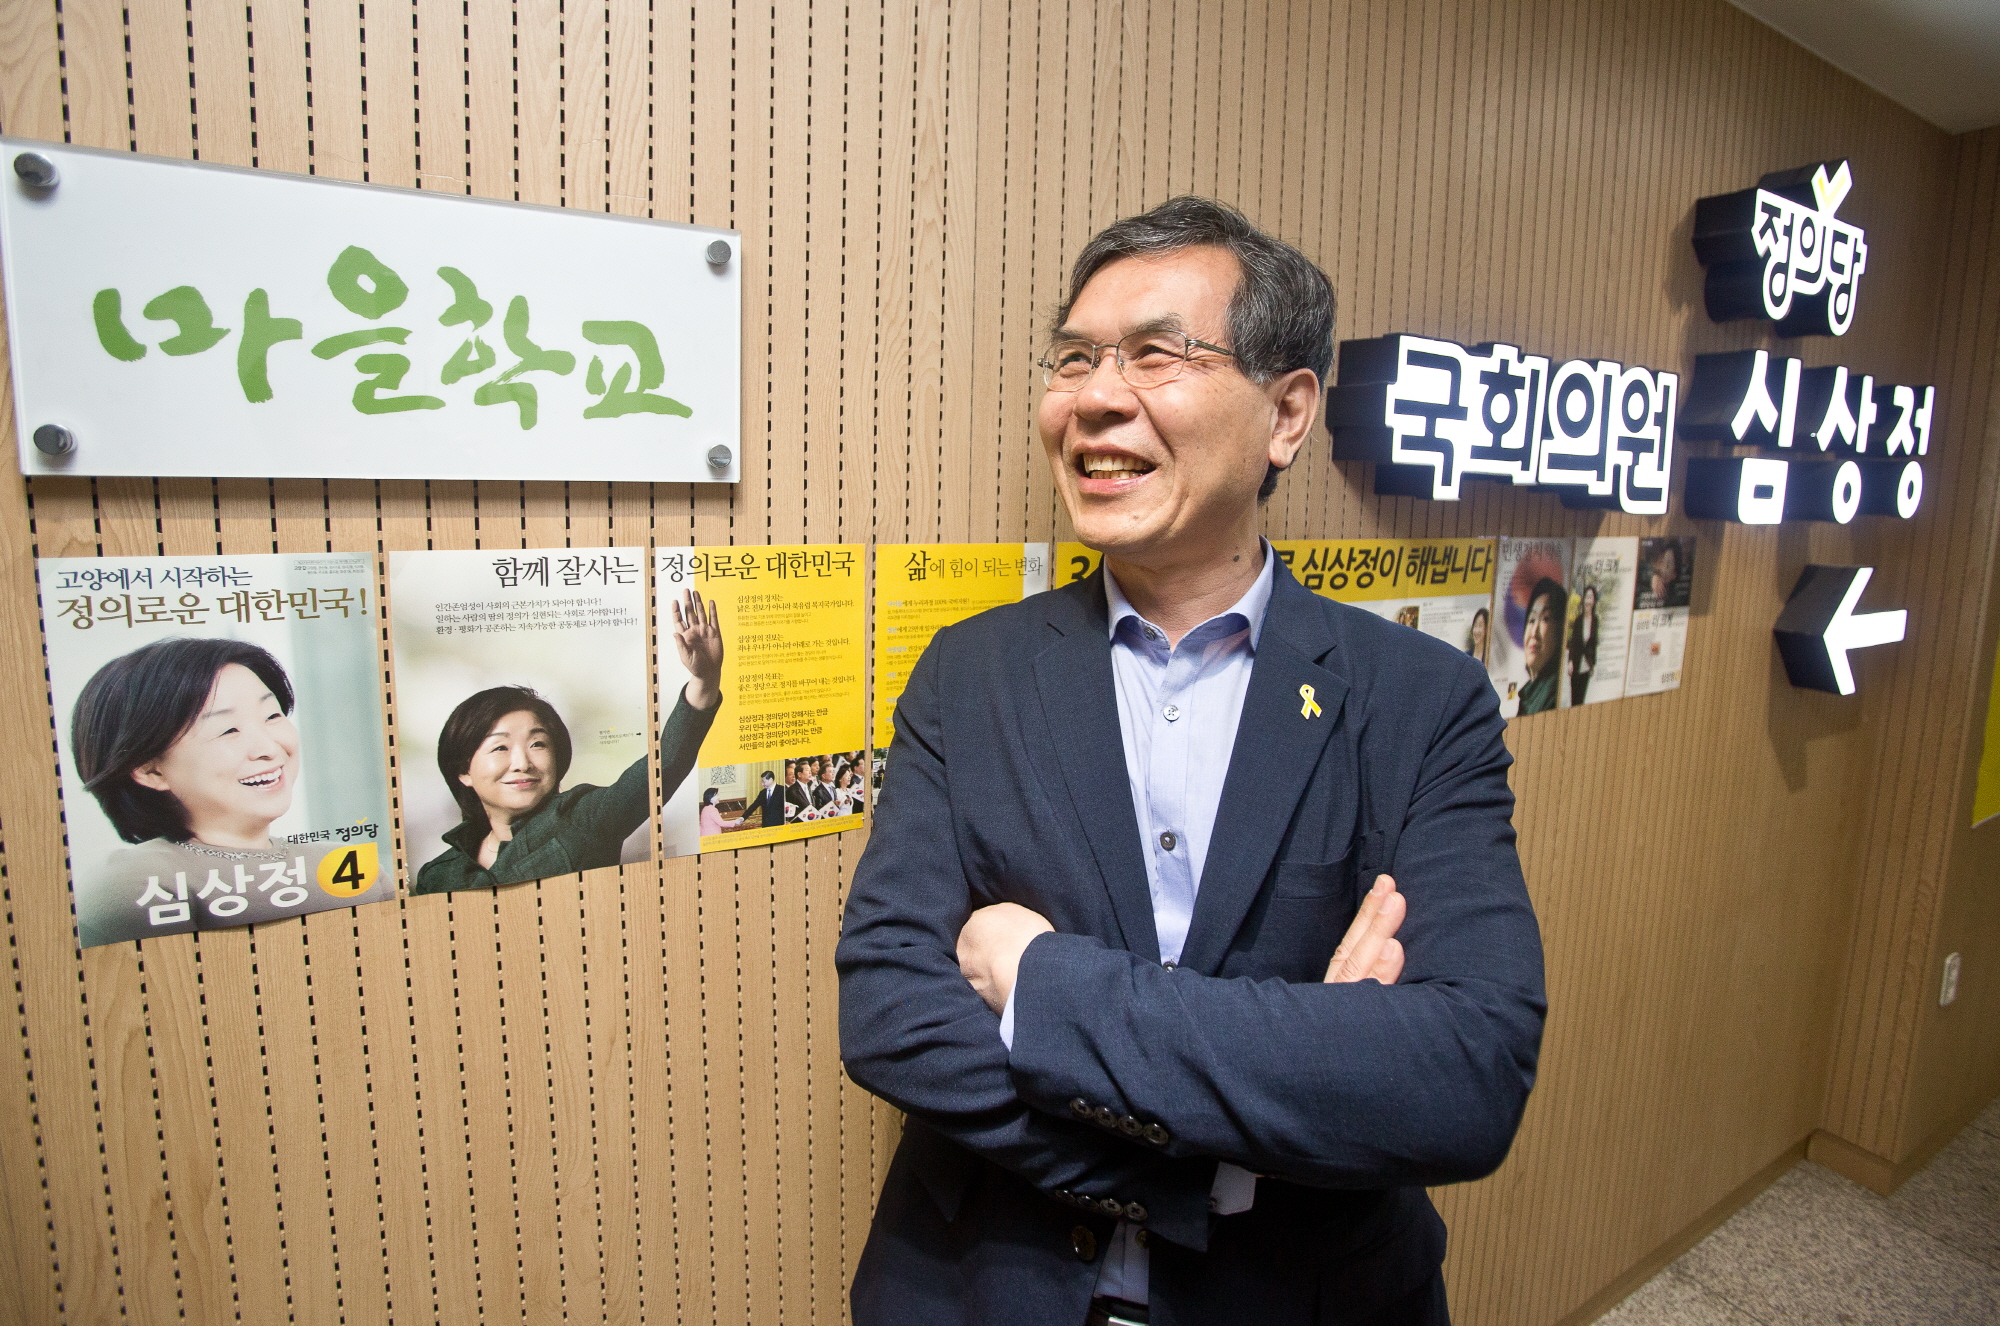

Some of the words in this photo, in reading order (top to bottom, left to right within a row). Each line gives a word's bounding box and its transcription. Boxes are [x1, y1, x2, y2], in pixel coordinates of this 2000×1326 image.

[1752, 187, 1868, 336] 정의당
[92, 244, 693, 431] 마을학교
[1385, 335, 1677, 515] 국회의원
[1731, 349, 1935, 526] 심상정
[492, 556, 550, 588] 함께
[556, 555, 639, 586] 잘사는
[660, 552, 761, 583] 정의로운
[765, 550, 855, 580] 대한민국
[904, 549, 945, 582] 삶에
[950, 557, 979, 578] 힘이
[982, 557, 1012, 577] 되는
[1015, 556, 1043, 577] 변화
[1301, 546, 1404, 590] 심상정이
[1405, 544, 1493, 586] 해냅니다
[55, 567, 154, 592] 고양에서
[159, 565, 253, 589] 시작하는
[435, 602, 484, 611] 인간존엄성이
[485, 601, 509, 610] 사회의
[511, 600, 550, 609] 근본가치가
[552, 599, 574, 607] 되어야
[576, 598, 602, 607] 합니다!
[737, 595, 763, 603] 심상정의
[764, 594, 783, 602] 정치는
[56, 592, 211, 630] 정의로운
[218, 587, 368, 624] 대한민국!
[737, 604, 750, 613] 낡은
[752, 603, 771, 612] 진보가
[772, 602, 791, 611] 아니라
[435, 614, 461, 624] 일하는
[462, 613, 486, 622] 사람의
[488, 612, 504, 621] 땀의
[506, 611, 529, 620] 정의가
[531, 610, 562, 620] 실현되는
[563, 609, 586, 618] 사회로
[436, 625, 453, 635] 환경
[458, 624, 482, 633] 평화가
[484, 623, 516, 632] 공존하는
[518, 621, 556, 631] 지속가능한
[558, 620, 587, 629] 공동체로
[589, 619, 611, 627] 나가야
[613, 618, 638, 627] 합니다!
[737, 635, 763, 643] 심상정의
[764, 633, 784, 642] 진보는
[772, 641, 791, 650] 아니라
[792, 640, 811, 648] 아래로
[738, 673, 763, 682] 심상정의
[765, 672, 784, 680] 목표는
[738, 684, 751, 692] 좋은
[752, 682, 778, 691] 정당으로
[780, 680, 798, 688] 정치를
[738, 714, 764, 723] 심상정과
[765, 711, 790, 721] 정의당이
[791, 709, 815, 719] 강해지는
[816, 707, 828, 716] 만큼
[738, 724, 752, 732] 우리
[752, 721, 784, 731] 민주주의가
[785, 718, 817, 728] 강해집니다.
[738, 732, 764, 742] 심상정과
[765, 730, 790, 739] 정의당이
[791, 728, 809, 737] 커지는
[810, 726, 823, 735] 만큼
[738, 741, 764, 750] 서민들의
[765, 739, 778, 748] 삶이
[779, 736, 811, 747] 좋아집니다.
[287, 829, 330, 845] 대한민국
[335, 821, 379, 843] 정의당
[135, 854, 308, 926] 심상정
[331, 850, 365, 891] 4
